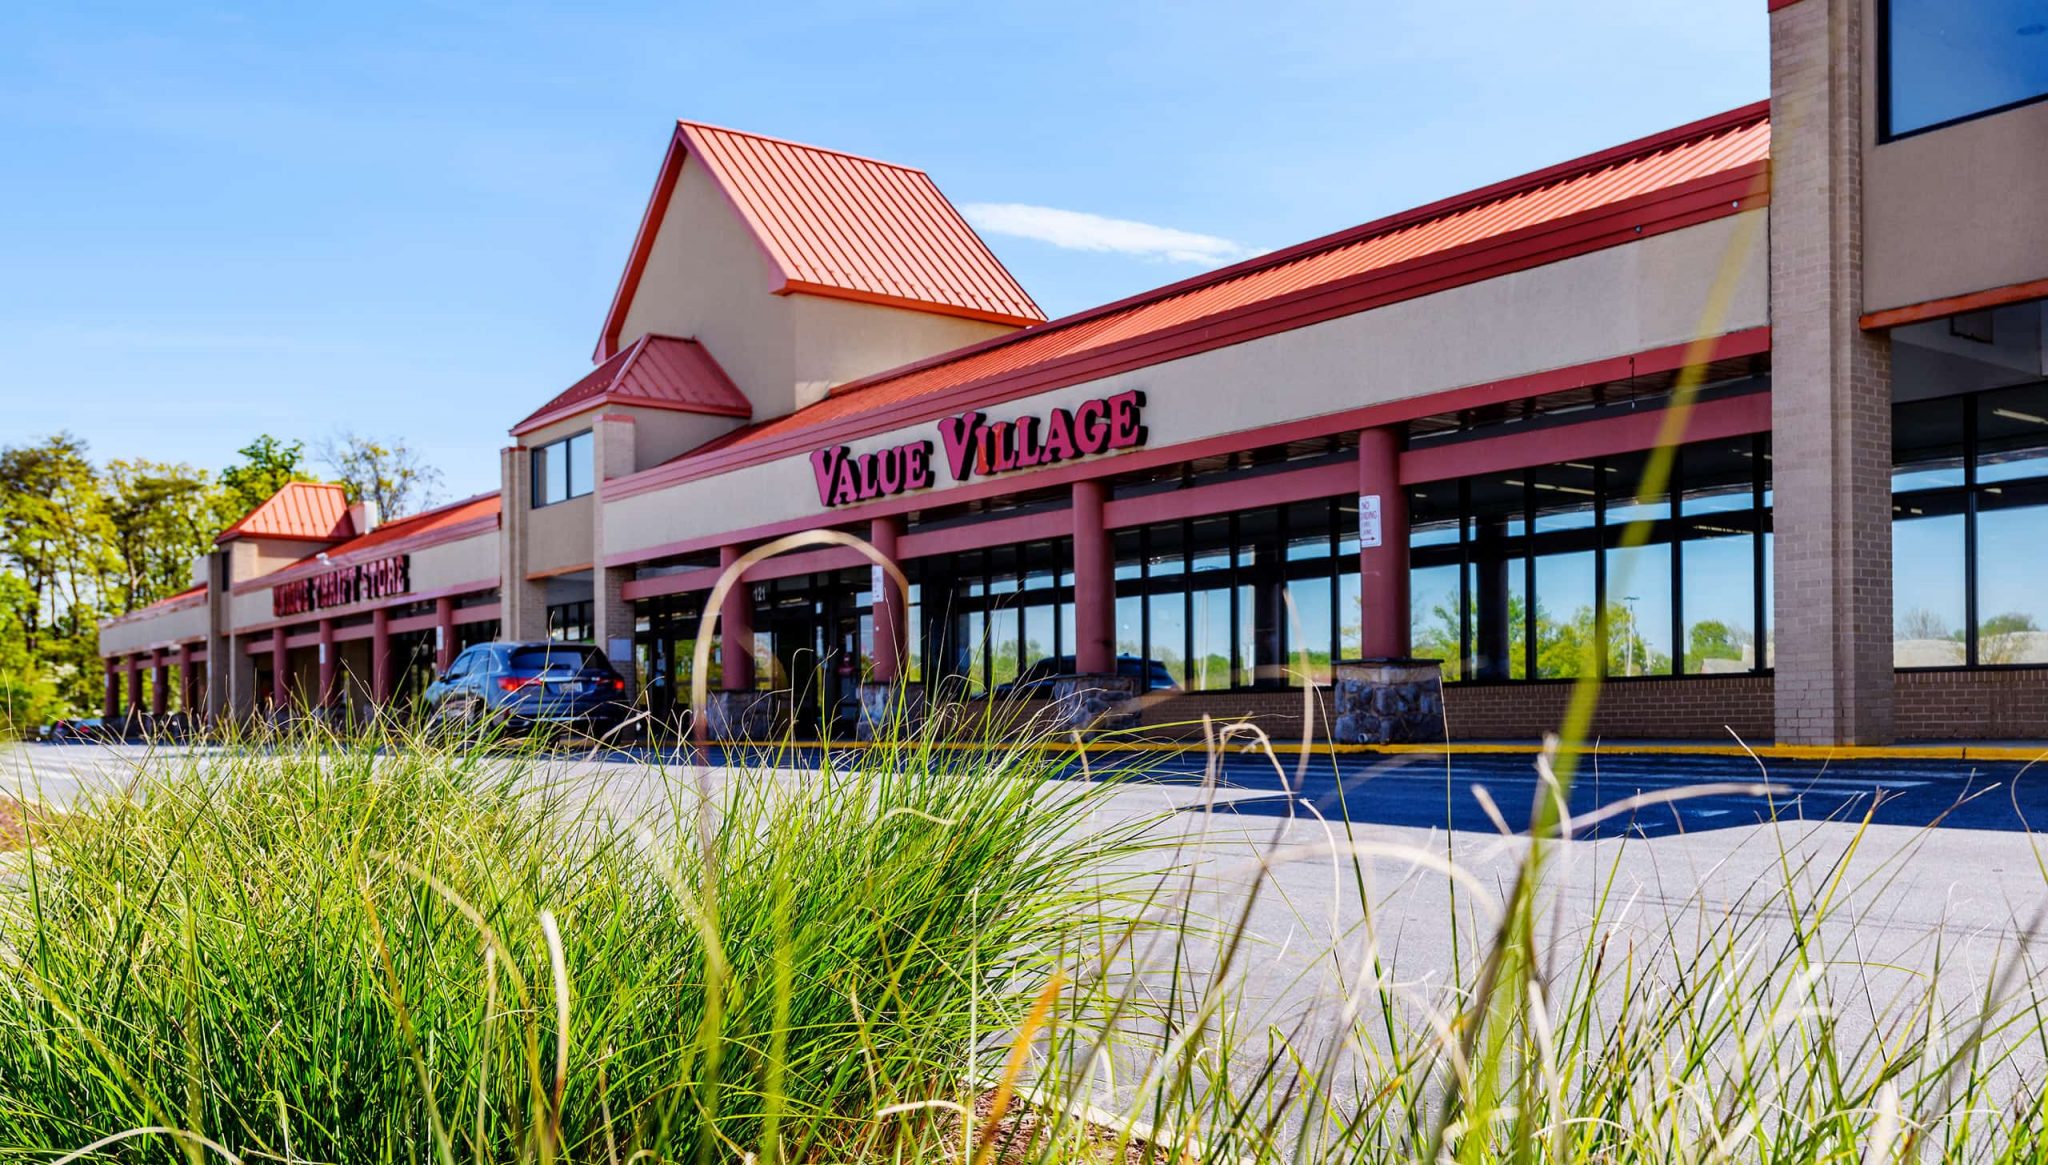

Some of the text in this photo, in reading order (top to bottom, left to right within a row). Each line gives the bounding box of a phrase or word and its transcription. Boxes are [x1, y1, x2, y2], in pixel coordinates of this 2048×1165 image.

[809, 389, 1149, 508] VALUE VILLAGE
[313, 566, 360, 609] THRIFT
[361, 554, 410, 599] STORE
